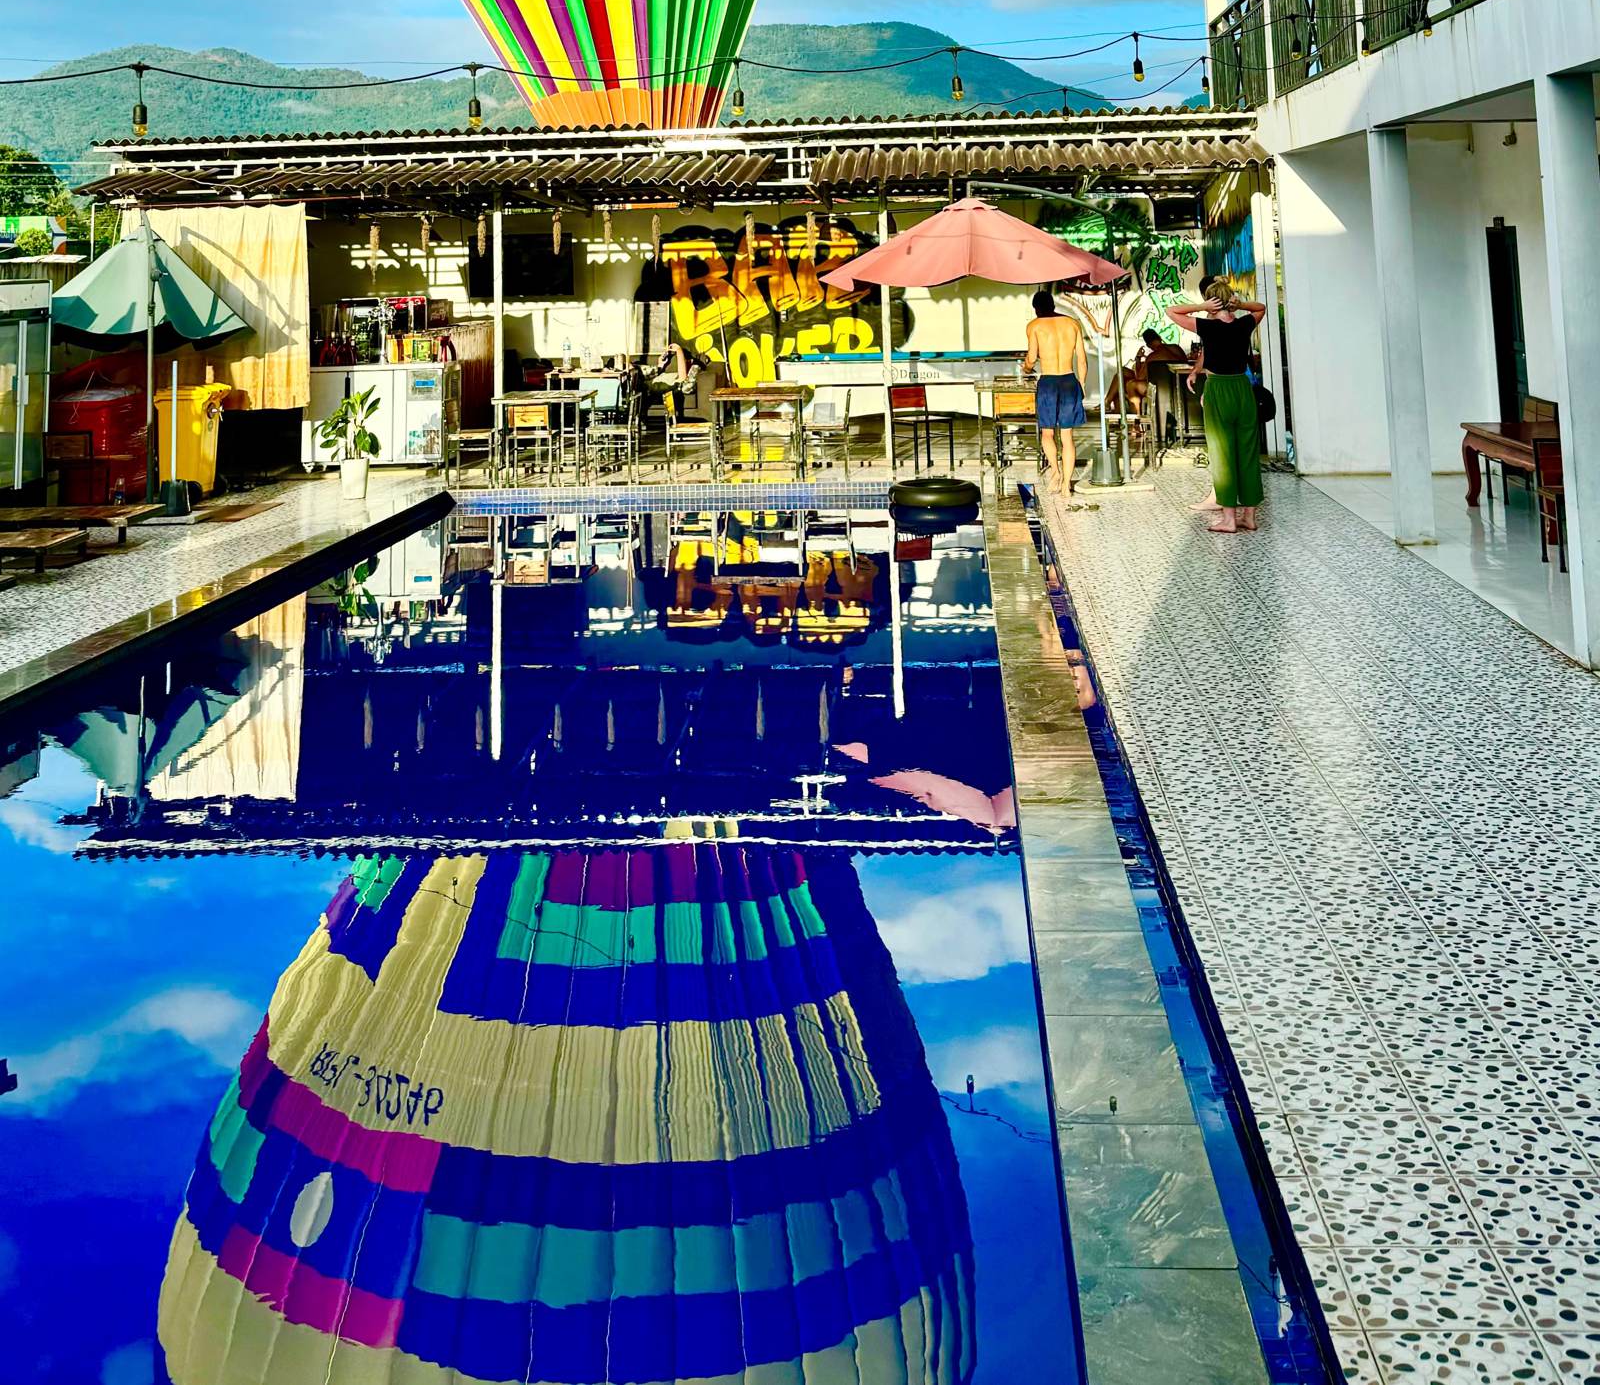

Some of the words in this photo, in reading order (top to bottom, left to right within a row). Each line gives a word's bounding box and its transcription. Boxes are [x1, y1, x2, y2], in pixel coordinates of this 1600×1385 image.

[662, 227, 871, 340] BAR
[1146, 257, 1181, 293] HA
[900, 369, 940, 381] Dragon
